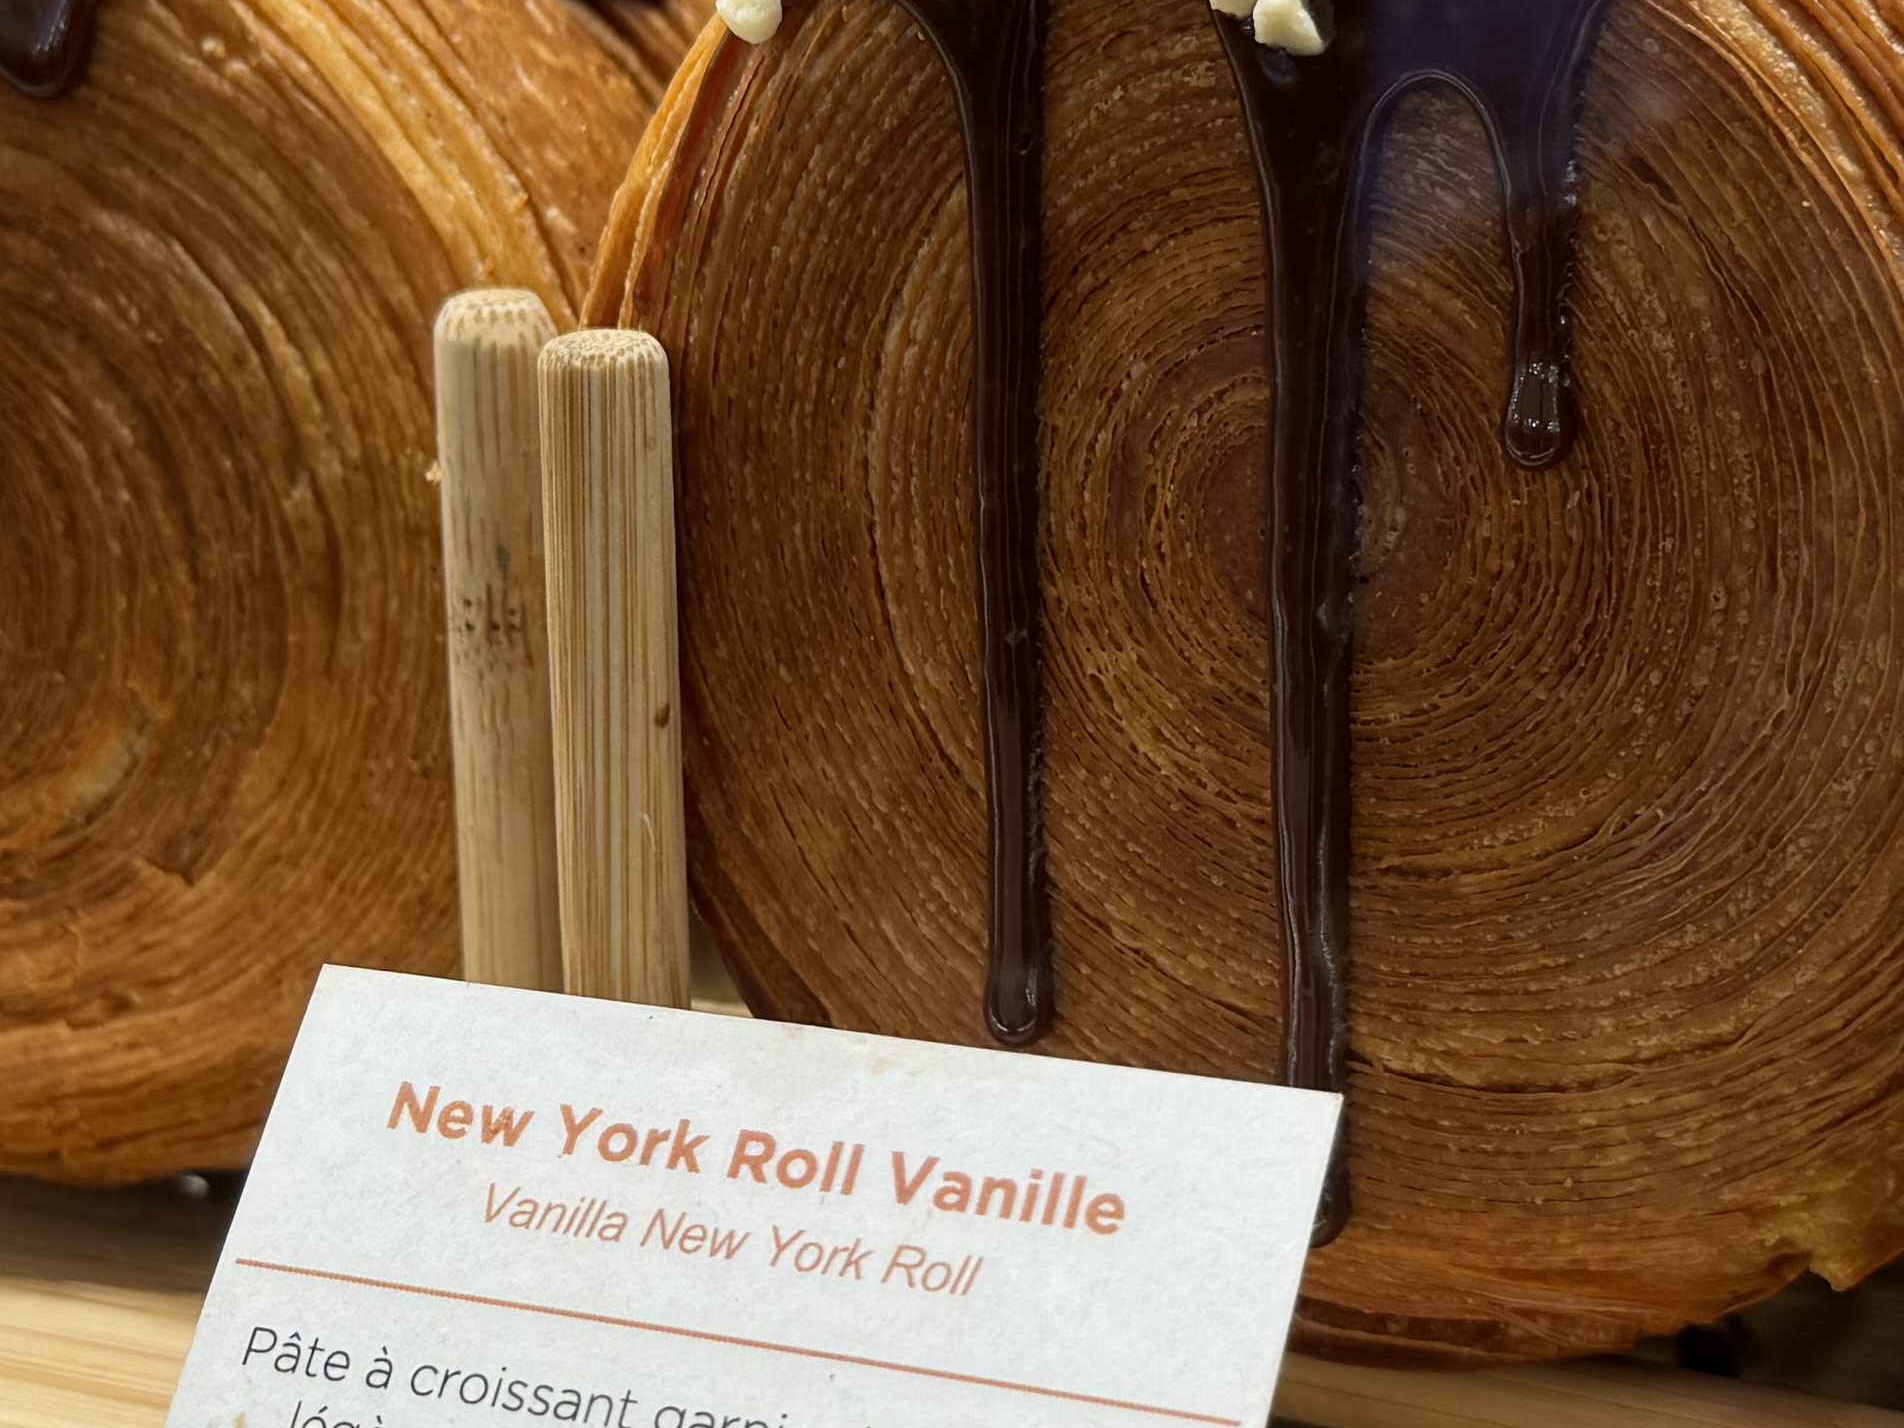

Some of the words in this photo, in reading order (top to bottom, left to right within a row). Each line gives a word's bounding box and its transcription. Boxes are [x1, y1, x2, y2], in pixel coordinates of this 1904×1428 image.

[385, 1080, 536, 1149] New
[559, 1103, 711, 1175] York
[726, 1128, 866, 1197] Roll
[891, 1150, 1126, 1237] Vanille
[484, 1182, 629, 1244] Vanilla
[639, 1207, 752, 1261] New
[768, 1224, 874, 1281] York
[880, 1243, 984, 1297] Roll
[241, 1326, 351, 1382] Pâte
[364, 1345, 394, 1391] à
